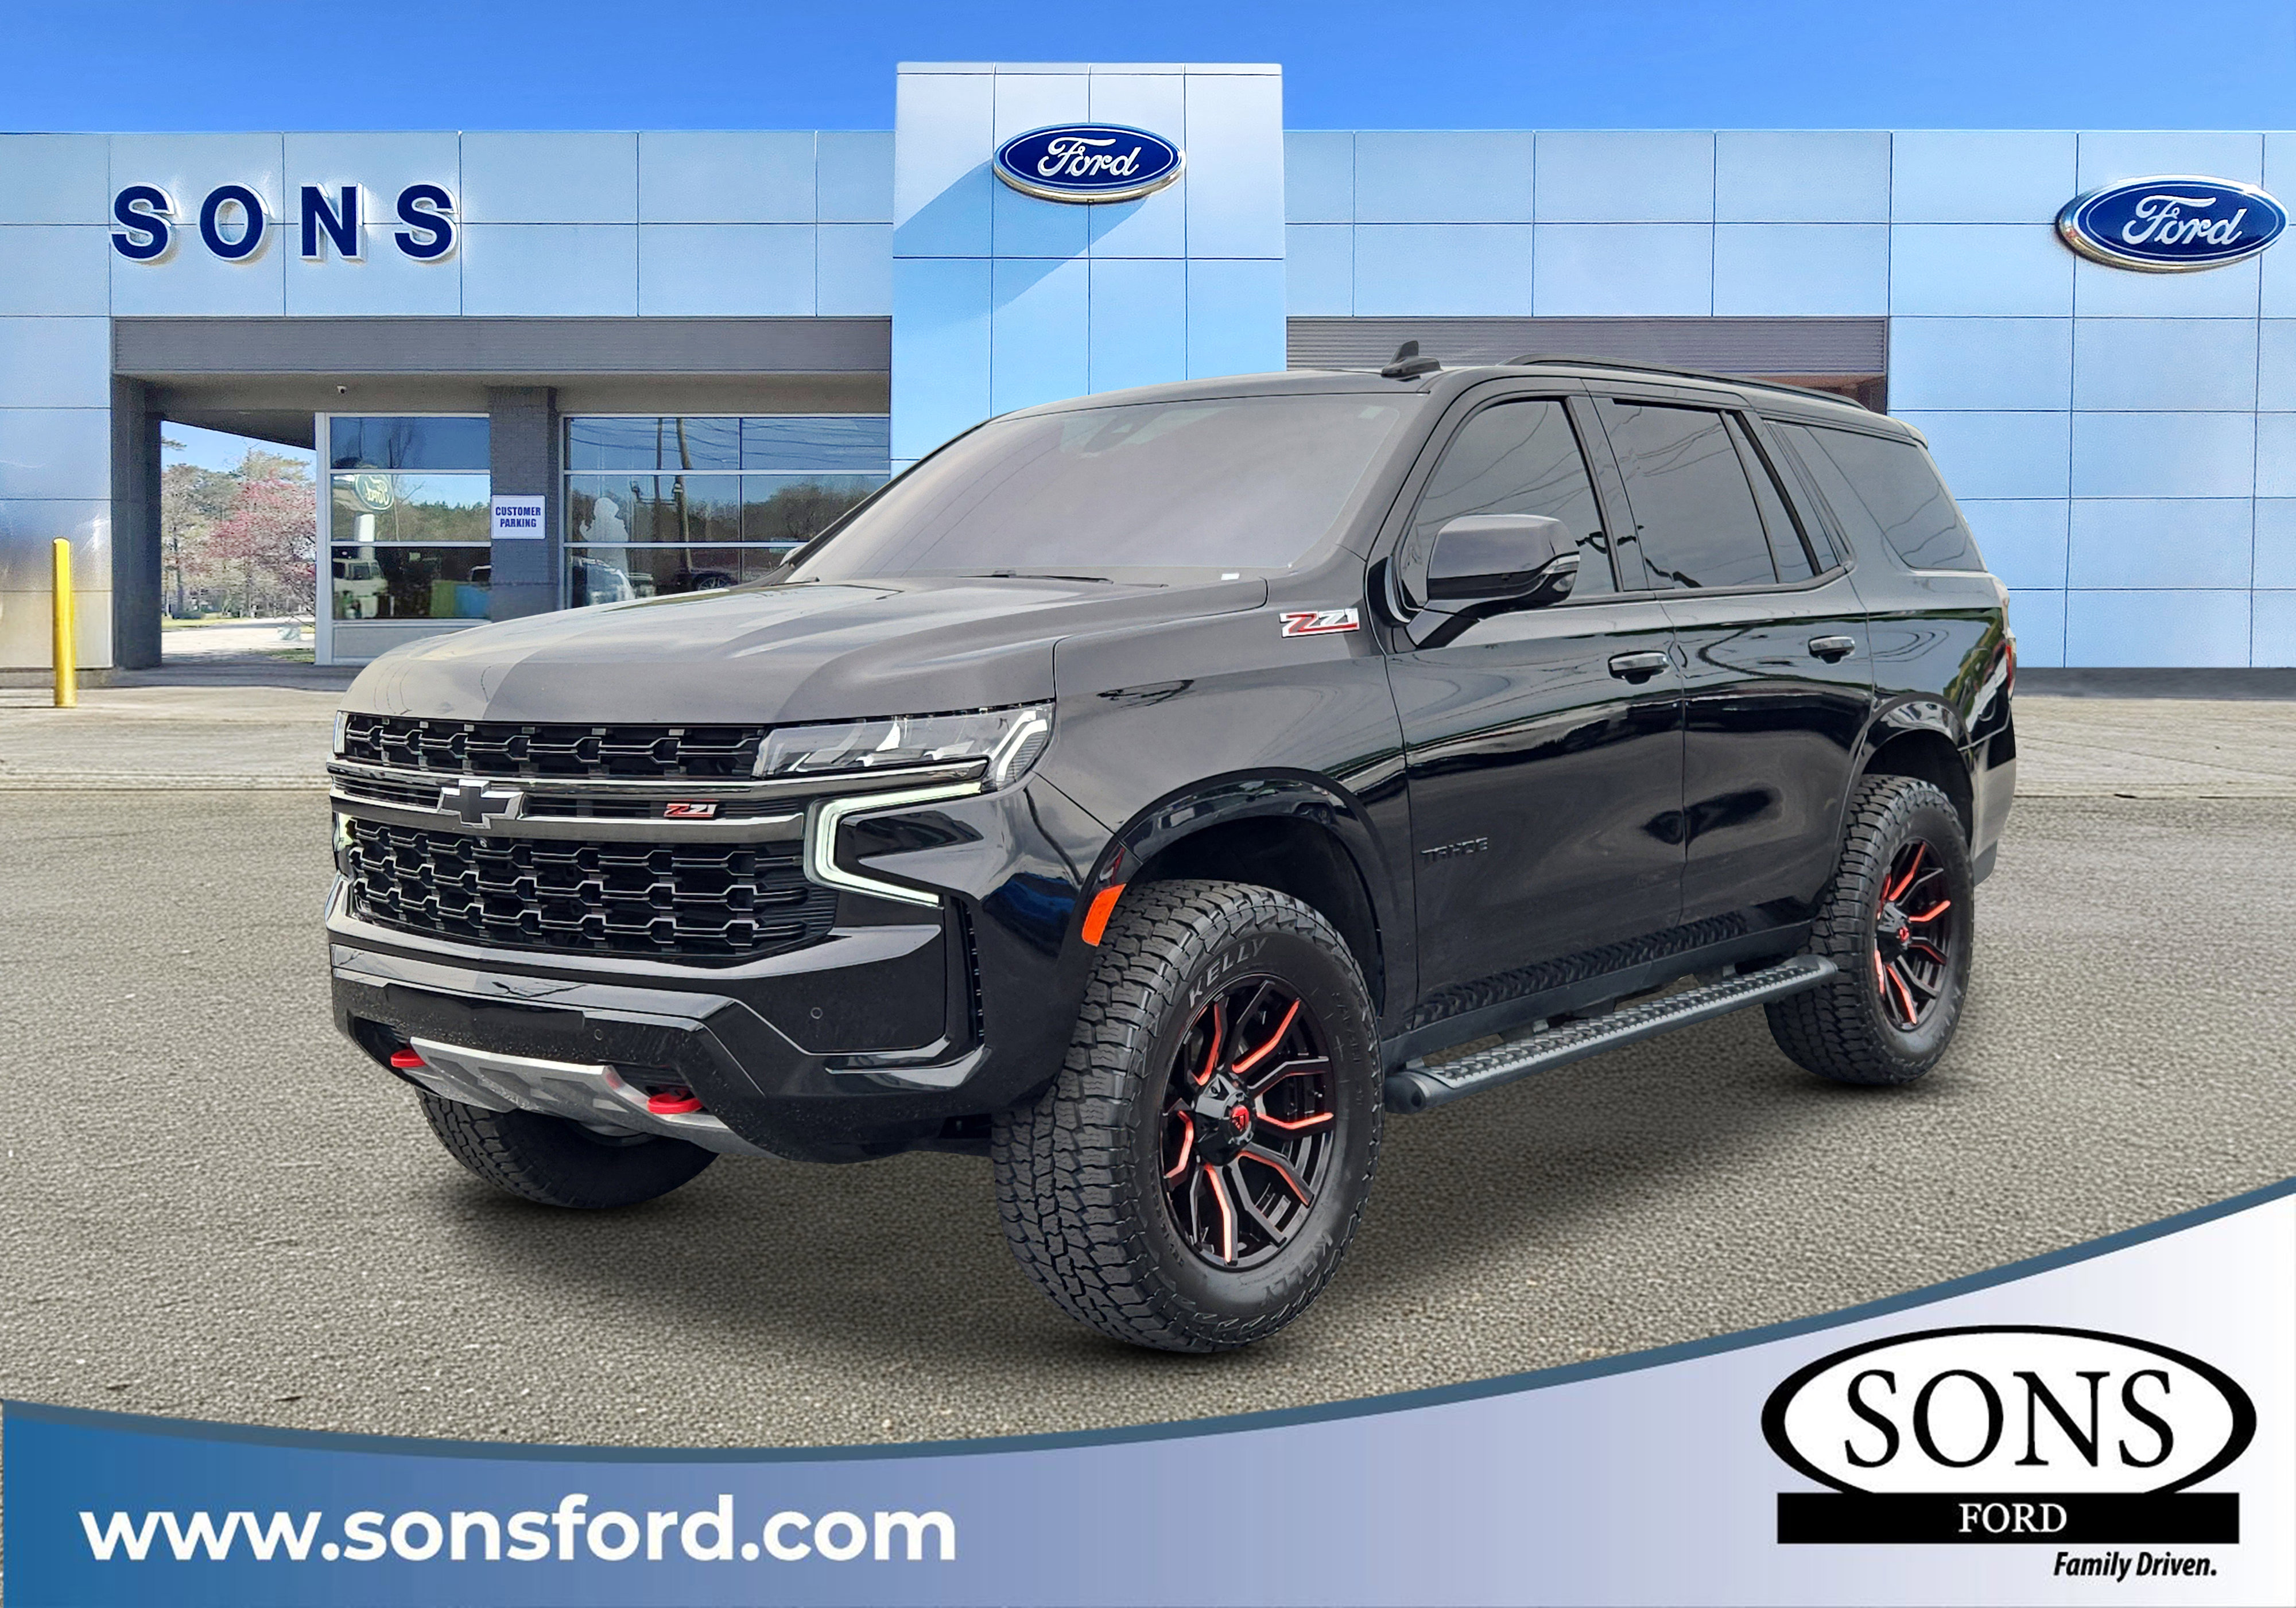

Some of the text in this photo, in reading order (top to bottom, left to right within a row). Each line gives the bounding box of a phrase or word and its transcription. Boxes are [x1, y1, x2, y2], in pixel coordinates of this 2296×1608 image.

[1038, 137, 1141, 177] Ford
[111, 183, 459, 262] SONS
[2122, 195, 2248, 245] Ford
[495, 506, 541, 516] CUSTOMER
[500, 518, 537, 527] PARKING
[1279, 608, 1360, 638] Z71
[664, 803, 717, 817] Z71
[1189, 936, 1269, 1009] KELLY
